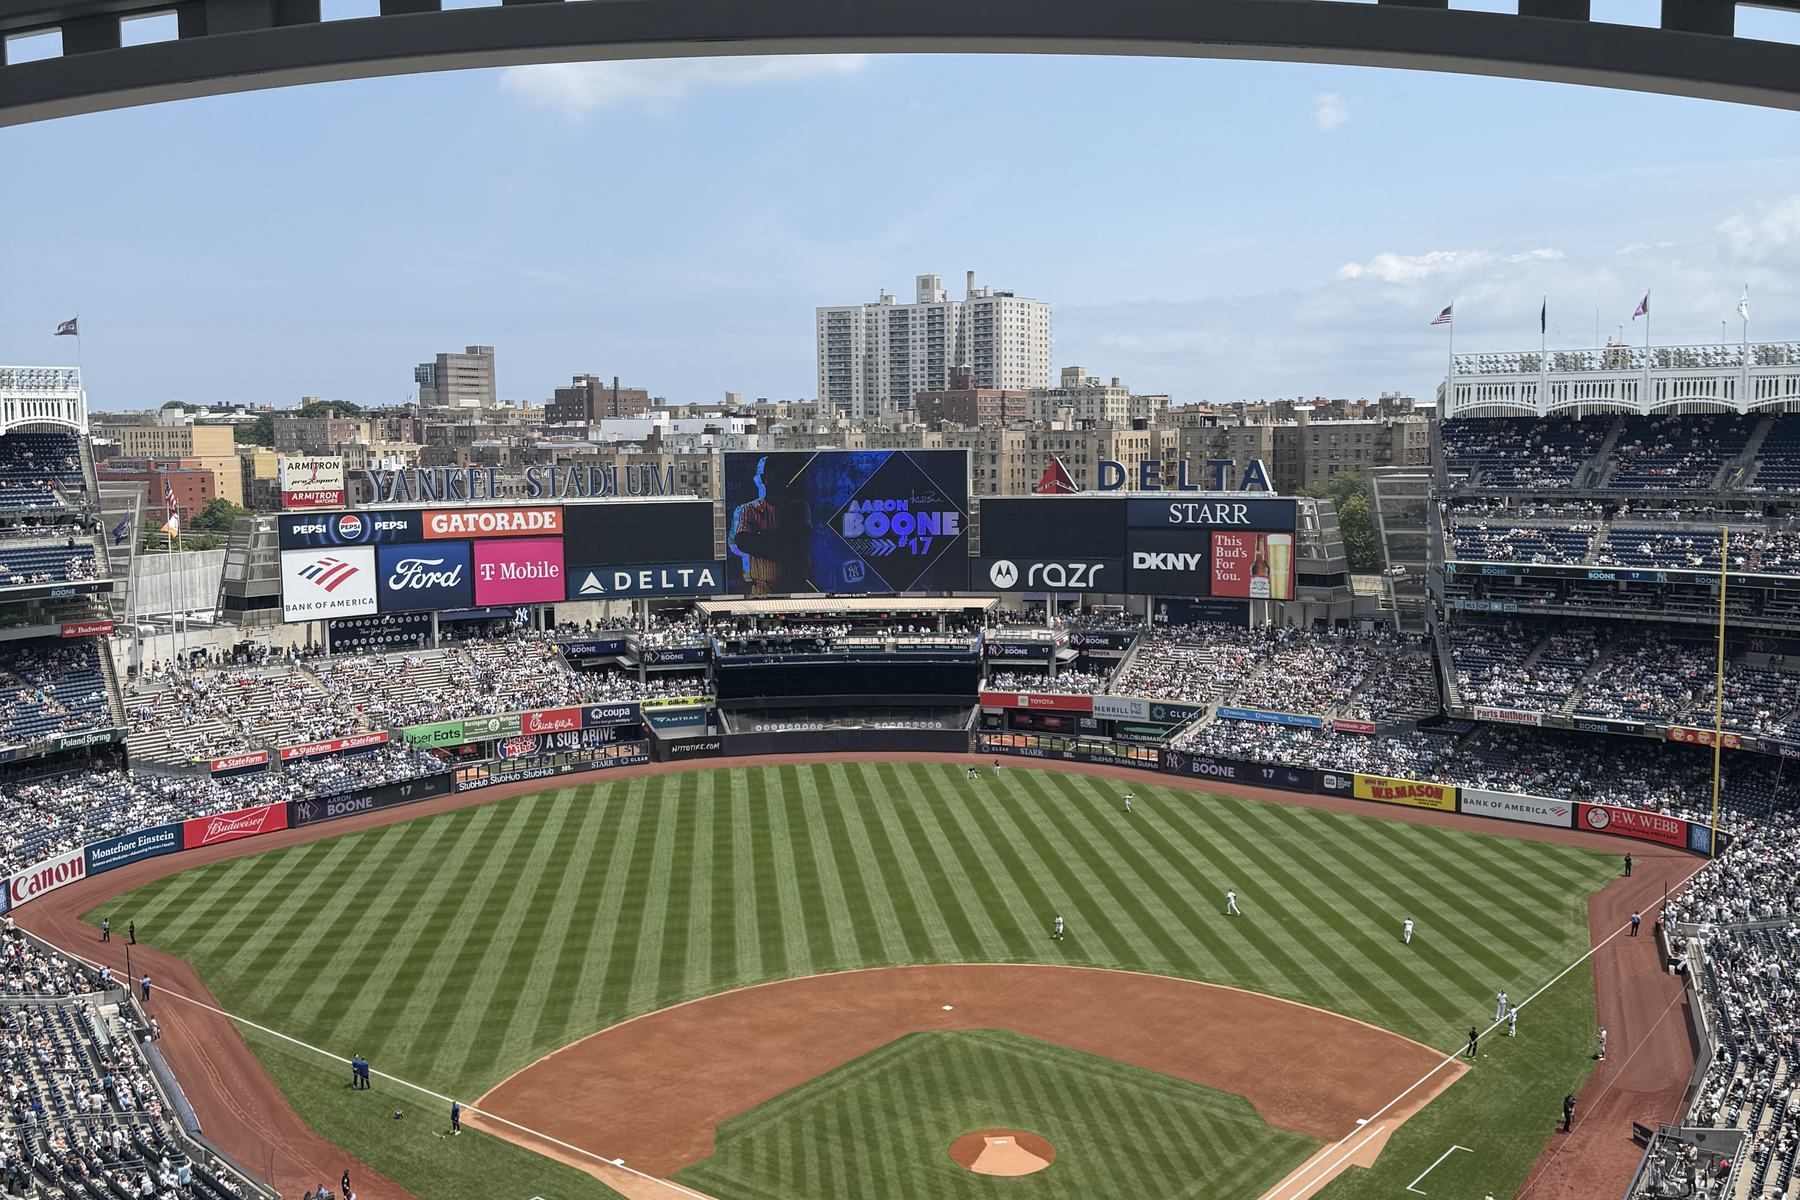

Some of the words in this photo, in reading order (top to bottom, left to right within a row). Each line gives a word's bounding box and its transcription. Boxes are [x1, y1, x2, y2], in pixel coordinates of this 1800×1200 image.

[287, 461, 340, 471] ARMITRON
[1098, 458, 1274, 492] DELTA
[366, 466, 506, 502] YANKEE
[524, 463, 677, 499] STADIUM
[291, 491, 339, 500] ARMITRON
[850, 500, 909, 512] AARON
[1168, 503, 1251, 525] STARR
[340, 522, 361, 531] PEPSI
[374, 520, 408, 531] PEPSI
[431, 511, 557, 534] GATORADE
[843, 511, 960, 538] BOONE
[292, 524, 327, 535] PEPSI
[1215, 534, 1242, 547] This
[1215, 546, 1248, 559] Bud's
[1132, 552, 1202, 571] DKNY
[1215, 558, 1236, 570] For
[388, 558, 463, 591] Ford
[499, 560, 560, 580] Mobile
[1028, 563, 1105, 588] razr
[1214, 570, 1241, 582] You.
[1588, 572, 1616, 580] BOONE
[614, 568, 716, 591] DELTA
[51, 588, 76, 597] BOONE
[285, 602, 313, 612] BANK
[315, 601, 328, 609] OF
[329, 597, 375, 608] AMERICA
[77, 624, 113, 634] Budweiser
[571, 646, 596, 654] BOONE
[660, 653, 684, 661] BOONE
[603, 707, 631, 718] coupa
[1094, 705, 1129, 714] MERRILL
[1476, 709, 1499, 718] Parts
[1499, 710, 1538, 723] Authority
[1578, 722, 1608, 732] BOONE
[60, 736, 86, 750] Poland
[86, 732, 112, 744] Spring
[434, 729, 461, 741] Eats
[546, 734, 555, 749] A
[557, 730, 579, 748] SUB
[582, 726, 617, 746] ABOVE
[671, 742, 720, 753] NITTOTIRE.COM
[1019, 748, 1044, 757] STARR
[591, 760, 614, 769] STARR
[1090, 755, 1114, 763] StubHub
[1114, 757, 1137, 766] StubHub
[1137, 759, 1159, 769] StubHub
[1192, 757, 1215, 765] AARON
[1191, 763, 1235, 778] BOONE
[1262, 768, 1275, 779] 17
[458, 778, 488, 791] StubHub
[489, 773, 521, 786] StubHub
[522, 768, 554, 779] StubHub
[400, 785, 412, 796] 17
[327, 795, 352, 803] AARON
[327, 796, 373, 816] BOONE
[1463, 797, 1489, 808] BANK
[1490, 801, 1503, 809] OF
[1504, 803, 1548, 815] AMERICA
[207, 815, 264, 835] Budweiser
[1612, 810, 1636, 827] F.W.
[1639, 815, 1679, 834] WEBB
[91, 841, 137, 861] Montefiore
[138, 830, 174, 847] Einstein
[11, 855, 84, 902] Canon
